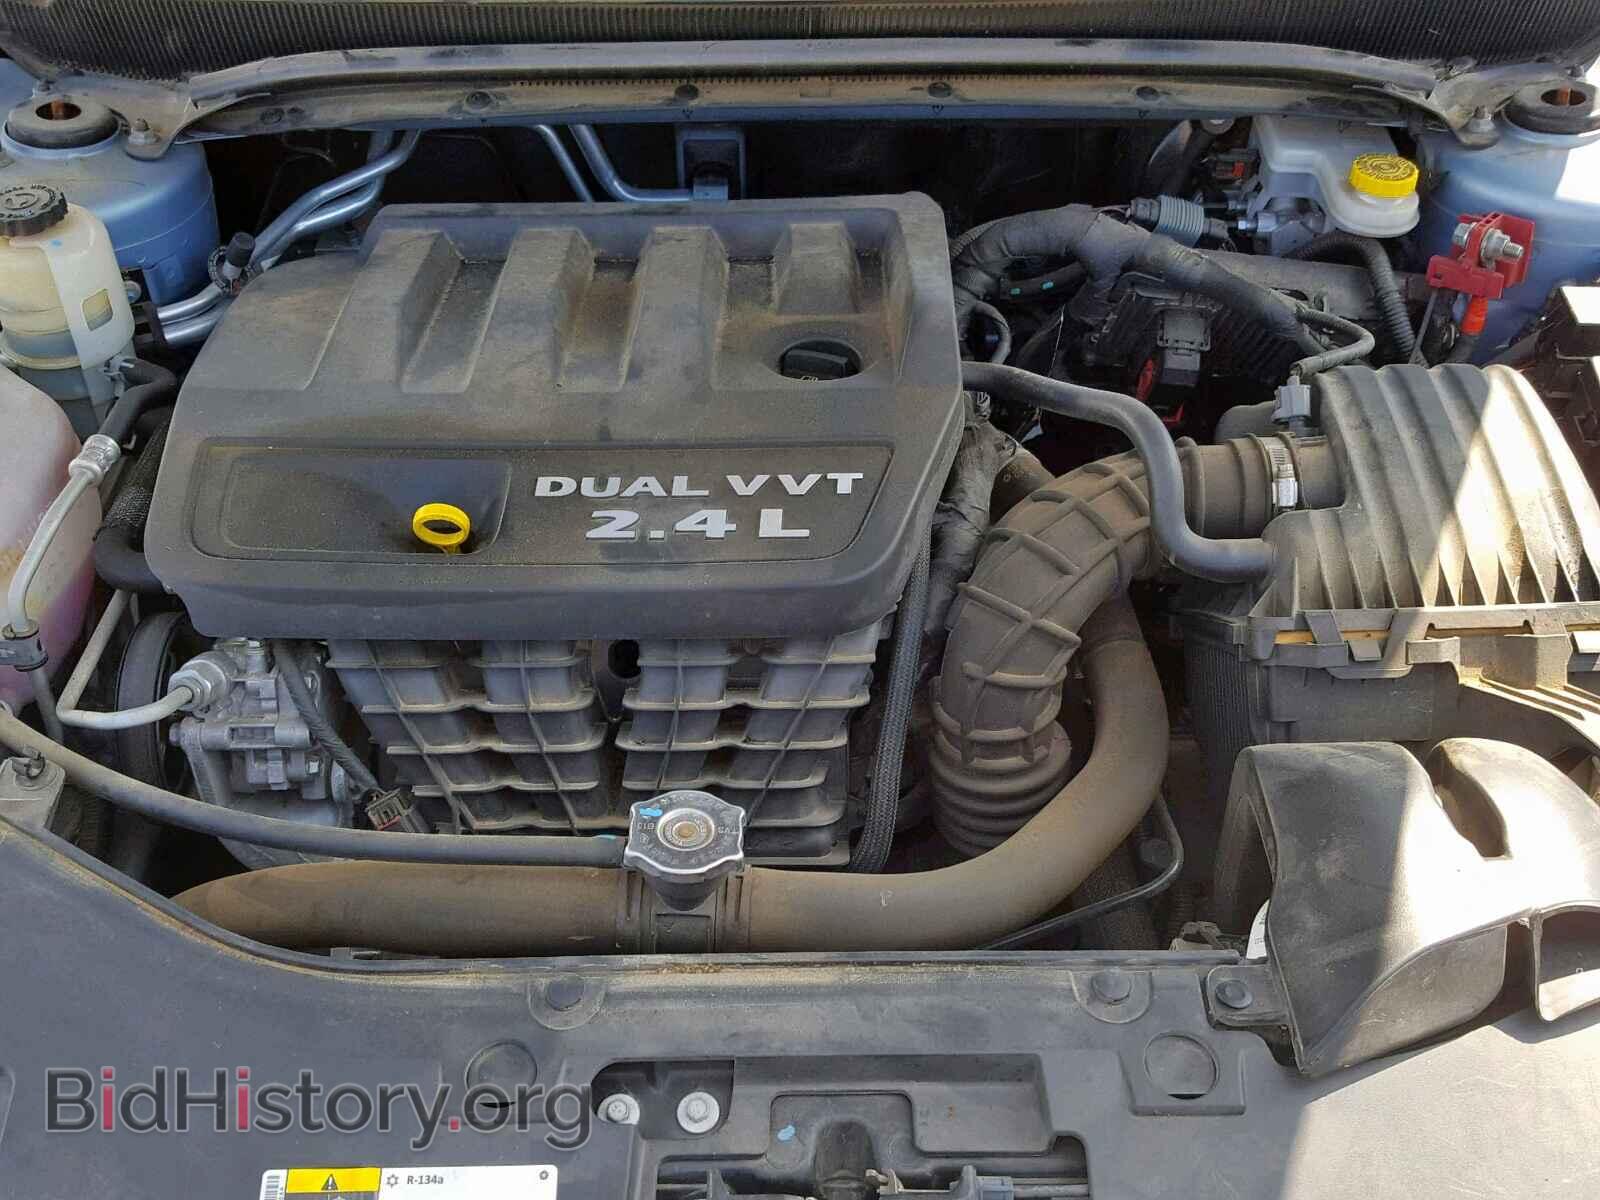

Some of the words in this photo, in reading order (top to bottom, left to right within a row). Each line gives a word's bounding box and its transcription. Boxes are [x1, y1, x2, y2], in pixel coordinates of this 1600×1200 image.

[535, 475, 710, 498] DUAL
[727, 473, 864, 497] VVT
[585, 508, 737, 540] 2.4
[759, 508, 811, 538] L
[407, 1175, 444, 1185] R-134a
